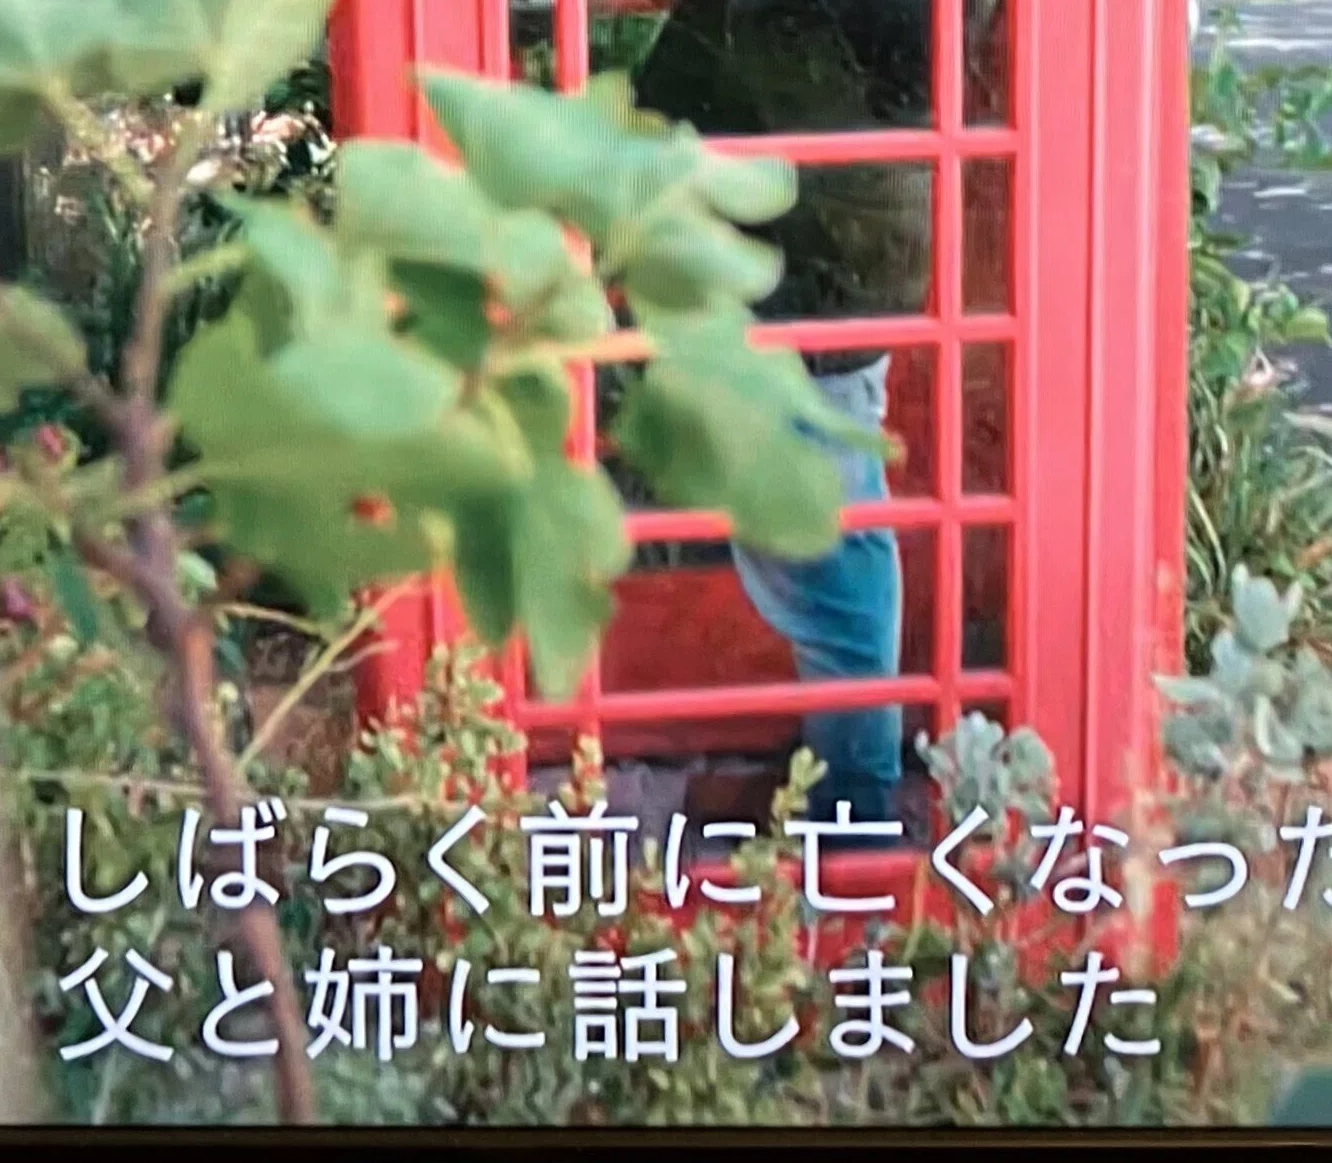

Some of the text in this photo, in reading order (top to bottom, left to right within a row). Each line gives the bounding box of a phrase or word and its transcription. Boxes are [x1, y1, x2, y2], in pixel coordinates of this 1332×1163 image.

[57, 945, 1163, 1063] 父と姉に話しました
